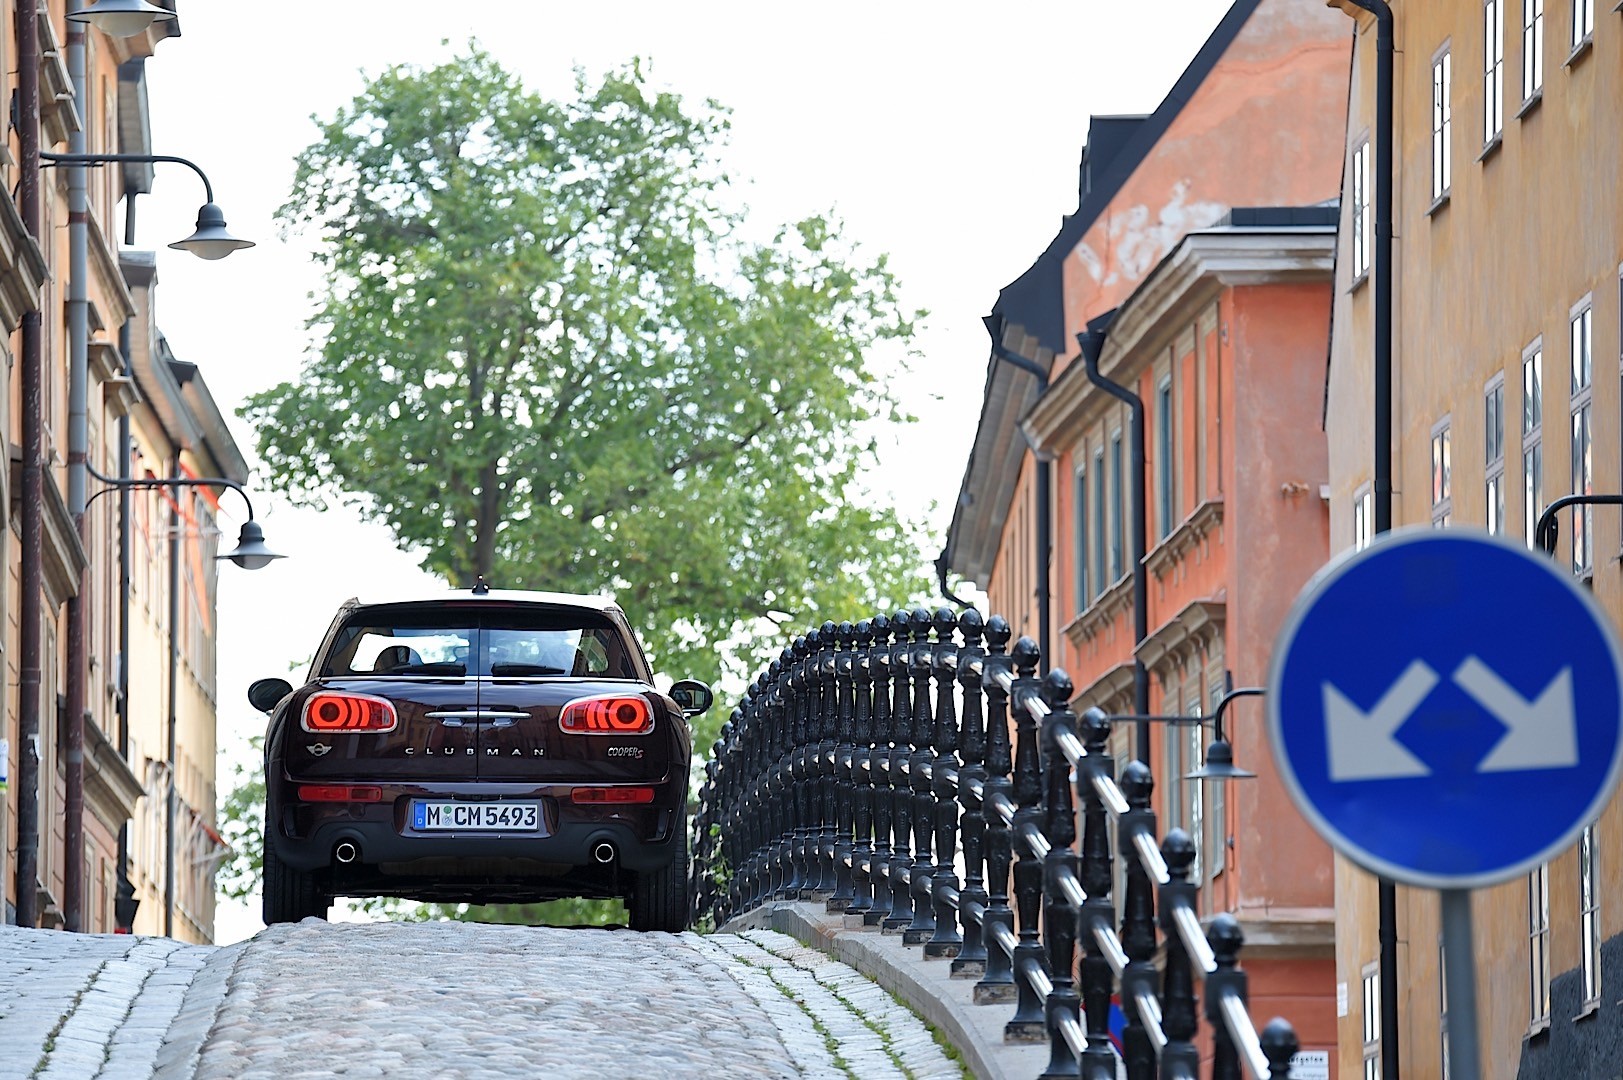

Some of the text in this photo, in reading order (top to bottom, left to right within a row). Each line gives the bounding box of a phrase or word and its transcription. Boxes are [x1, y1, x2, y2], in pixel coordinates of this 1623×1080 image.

[405, 747, 544, 755] CLUBMAN
[607, 747, 638, 757] COOPER
[427, 806, 440, 826] M
[454, 806, 480, 826] CM
[485, 806, 536, 826] 5493
